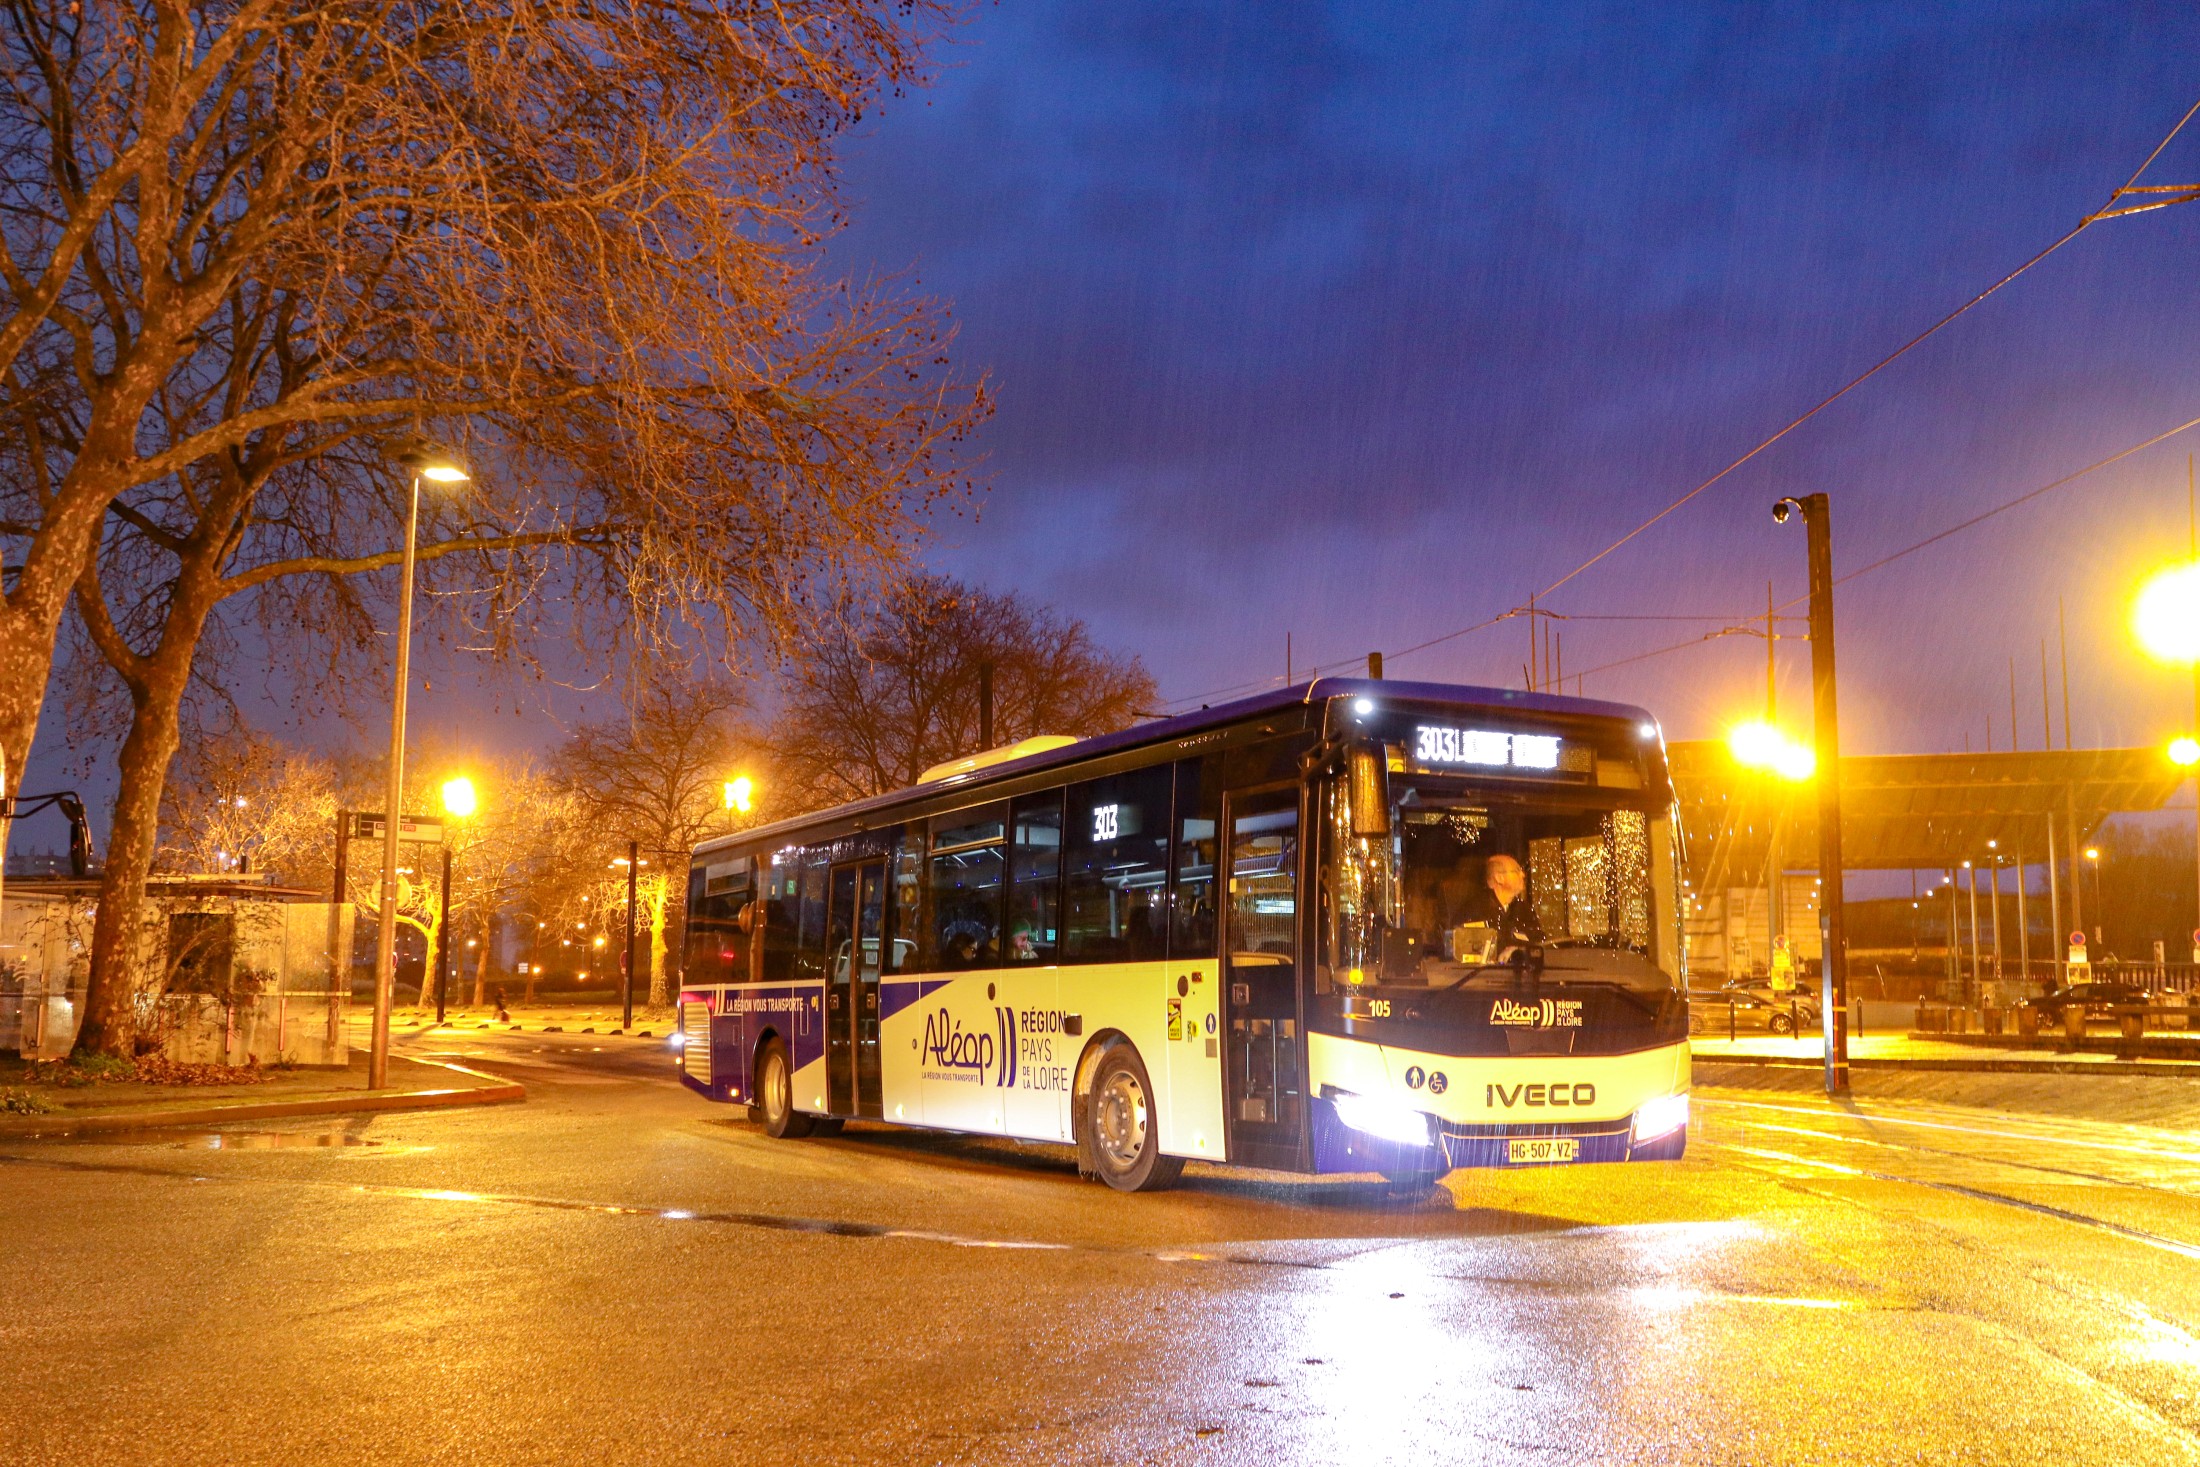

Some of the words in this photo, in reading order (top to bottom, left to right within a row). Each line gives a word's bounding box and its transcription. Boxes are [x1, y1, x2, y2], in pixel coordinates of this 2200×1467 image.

[1416, 726, 1454, 762] 303
[1093, 804, 1118, 841] 303
[726, 999, 733, 1012] LA
[733, 996, 752, 1012] RÉGION
[752, 998, 767, 1012] VOUS
[767, 997, 804, 1012] TRANSPORTE
[1368, 999, 1391, 1018] 105
[1556, 1009, 1575, 1018] PAYS
[1021, 1006, 1066, 1033] RÉGION
[1562, 1017, 1583, 1026] LOIRE
[1022, 1038, 1052, 1062] PAYS
[941, 1072, 952, 1081] VOUS
[952, 1073, 979, 1083] TRANSPORTE
[1022, 1066, 1031, 1077] DE
[1022, 1079, 1031, 1089] LA
[1033, 1066, 1068, 1092] LOIRE
[1486, 1083, 1596, 1109] IVECO
